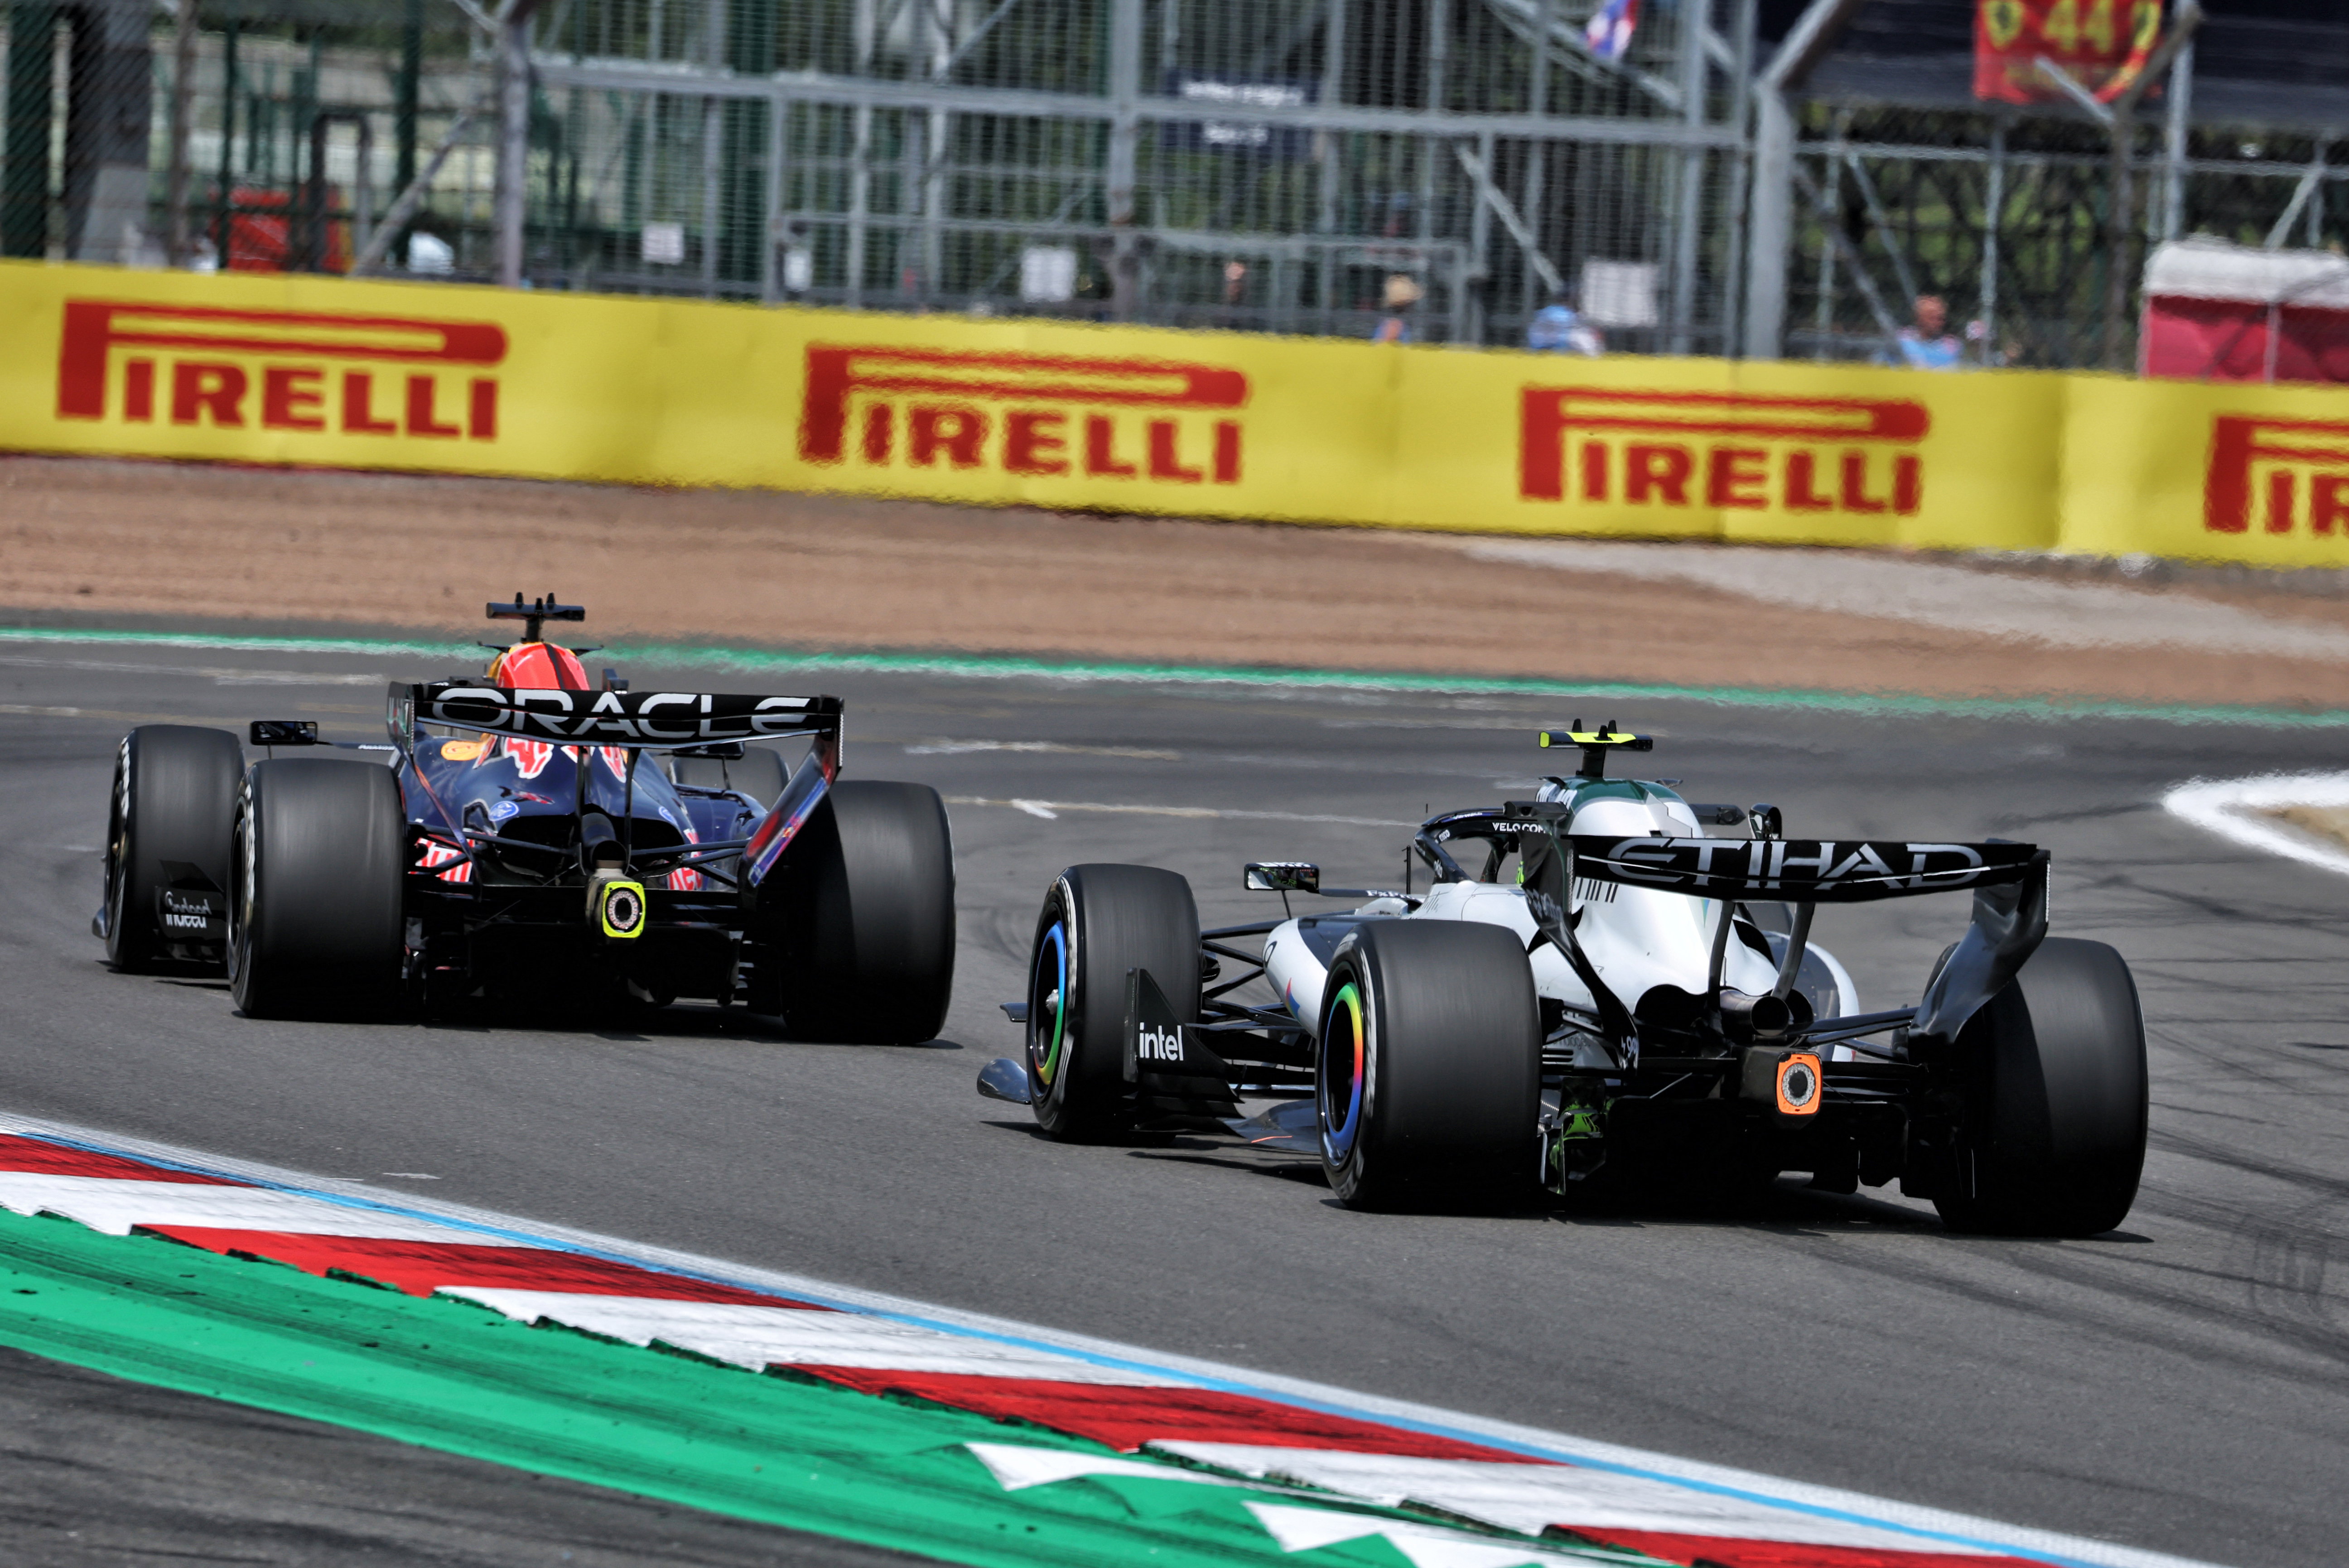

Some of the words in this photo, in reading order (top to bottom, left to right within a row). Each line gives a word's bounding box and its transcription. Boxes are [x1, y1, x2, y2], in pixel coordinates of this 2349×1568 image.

[55, 298, 507, 441] PIRELLI
[797, 343, 1249, 484] PIRELLI
[1518, 385, 1931, 516] PIRELLI
[433, 688, 810, 738] ORACLE
[1607, 838, 1983, 889] ETIHAD
[1139, 1022, 1183, 1061] intel
